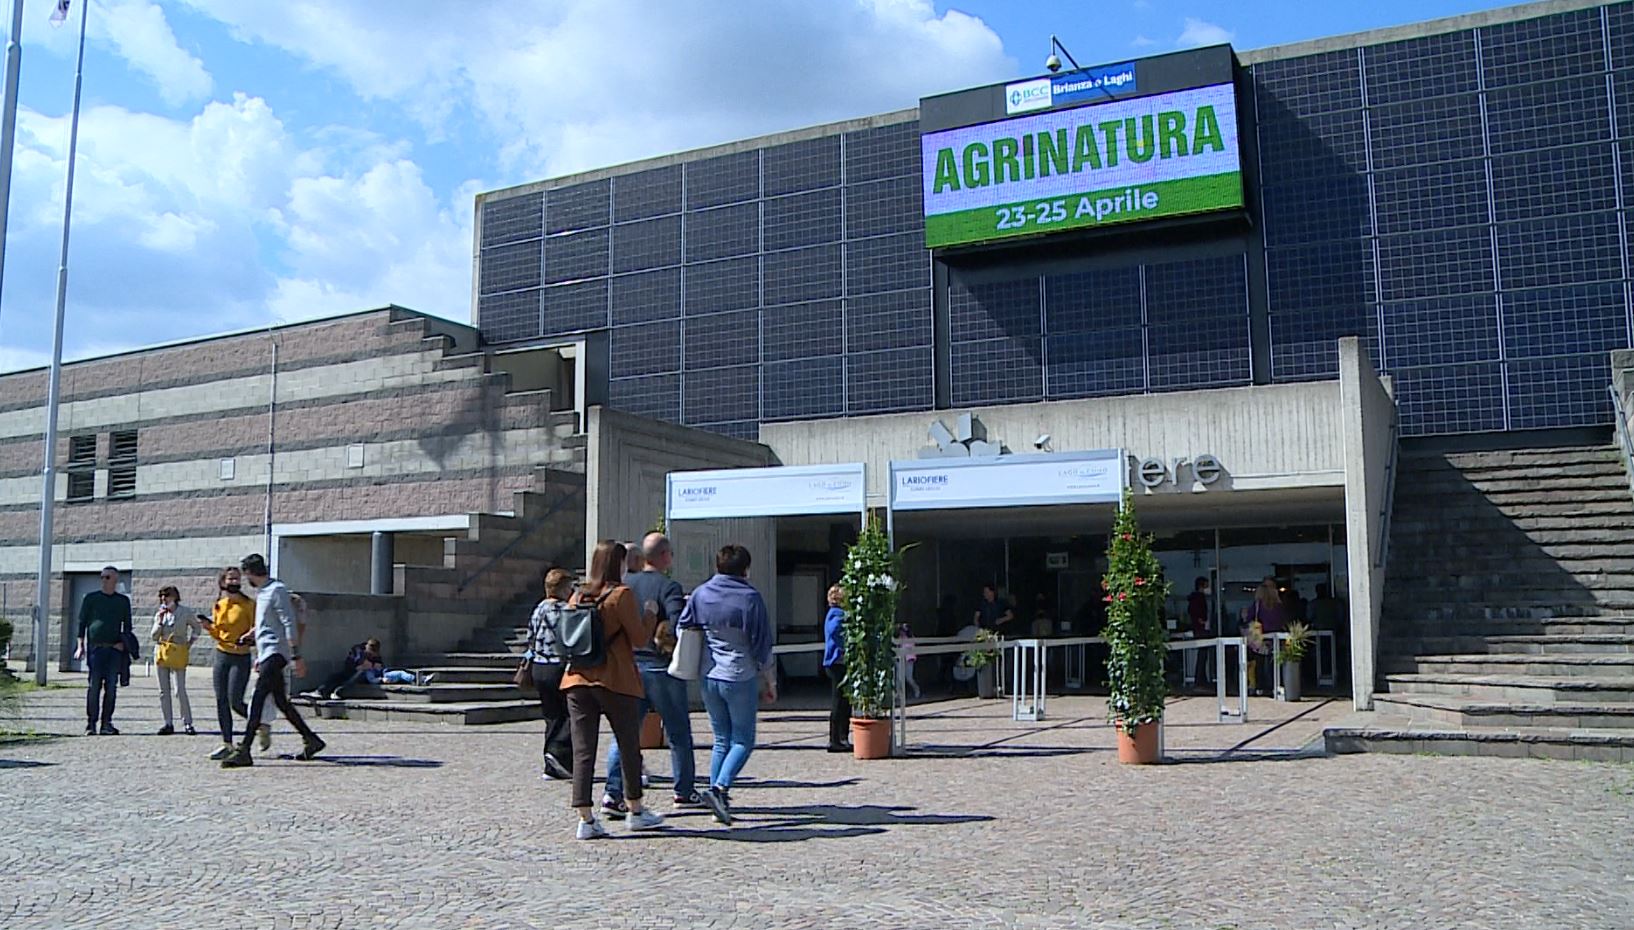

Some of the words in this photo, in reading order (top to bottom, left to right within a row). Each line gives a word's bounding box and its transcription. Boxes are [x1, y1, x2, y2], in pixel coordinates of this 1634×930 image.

[1023, 85, 1048, 98] BCC
[1053, 80, 1092, 95] Brianza
[1103, 71, 1133, 86] Laghi
[933, 105, 1225, 194] AGRINATURA
[996, 200, 1067, 230] 23-25
[1075, 188, 1159, 221] Aprile
[902, 475, 948, 486] LARIOFIERE
